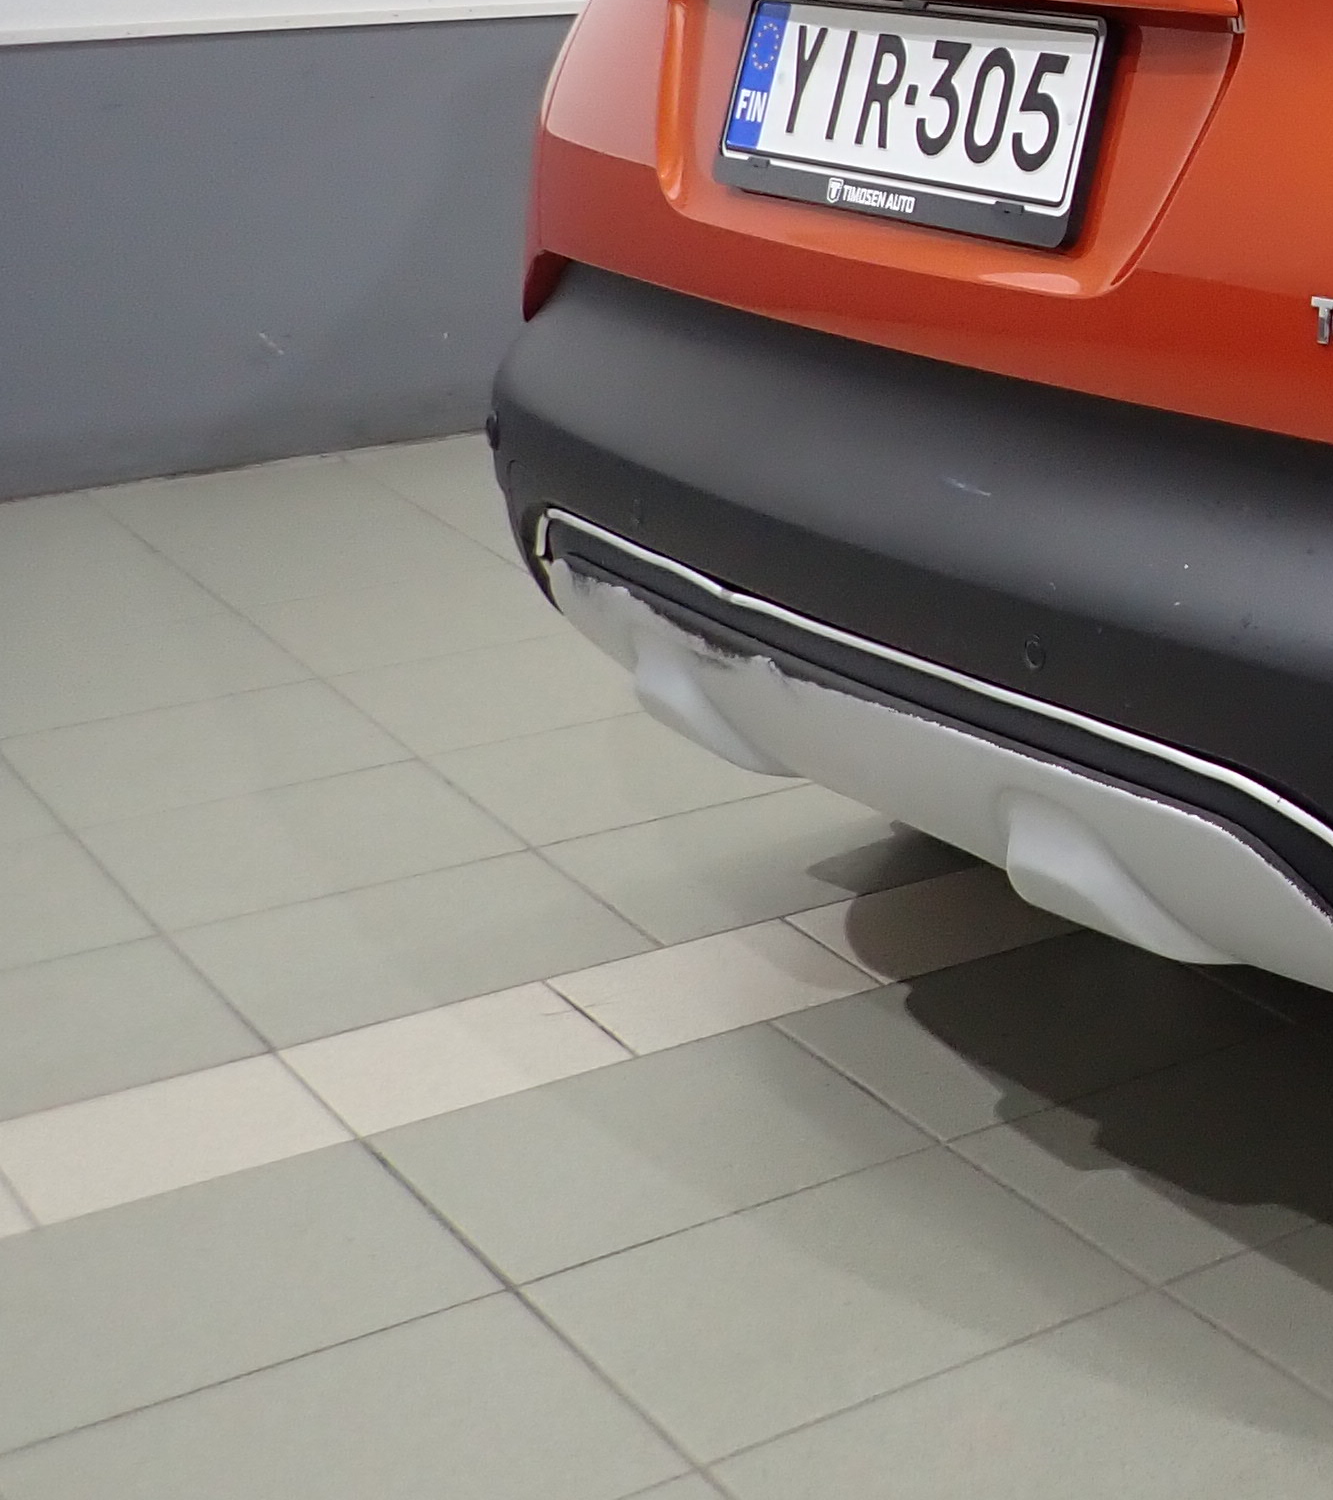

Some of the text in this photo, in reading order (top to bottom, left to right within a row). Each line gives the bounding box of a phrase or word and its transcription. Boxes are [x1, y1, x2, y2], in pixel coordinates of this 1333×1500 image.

[735, 88, 767, 123] FIN
[842, 184, 887, 208] TIMOSEN
[885, 192, 916, 214] AUTO
